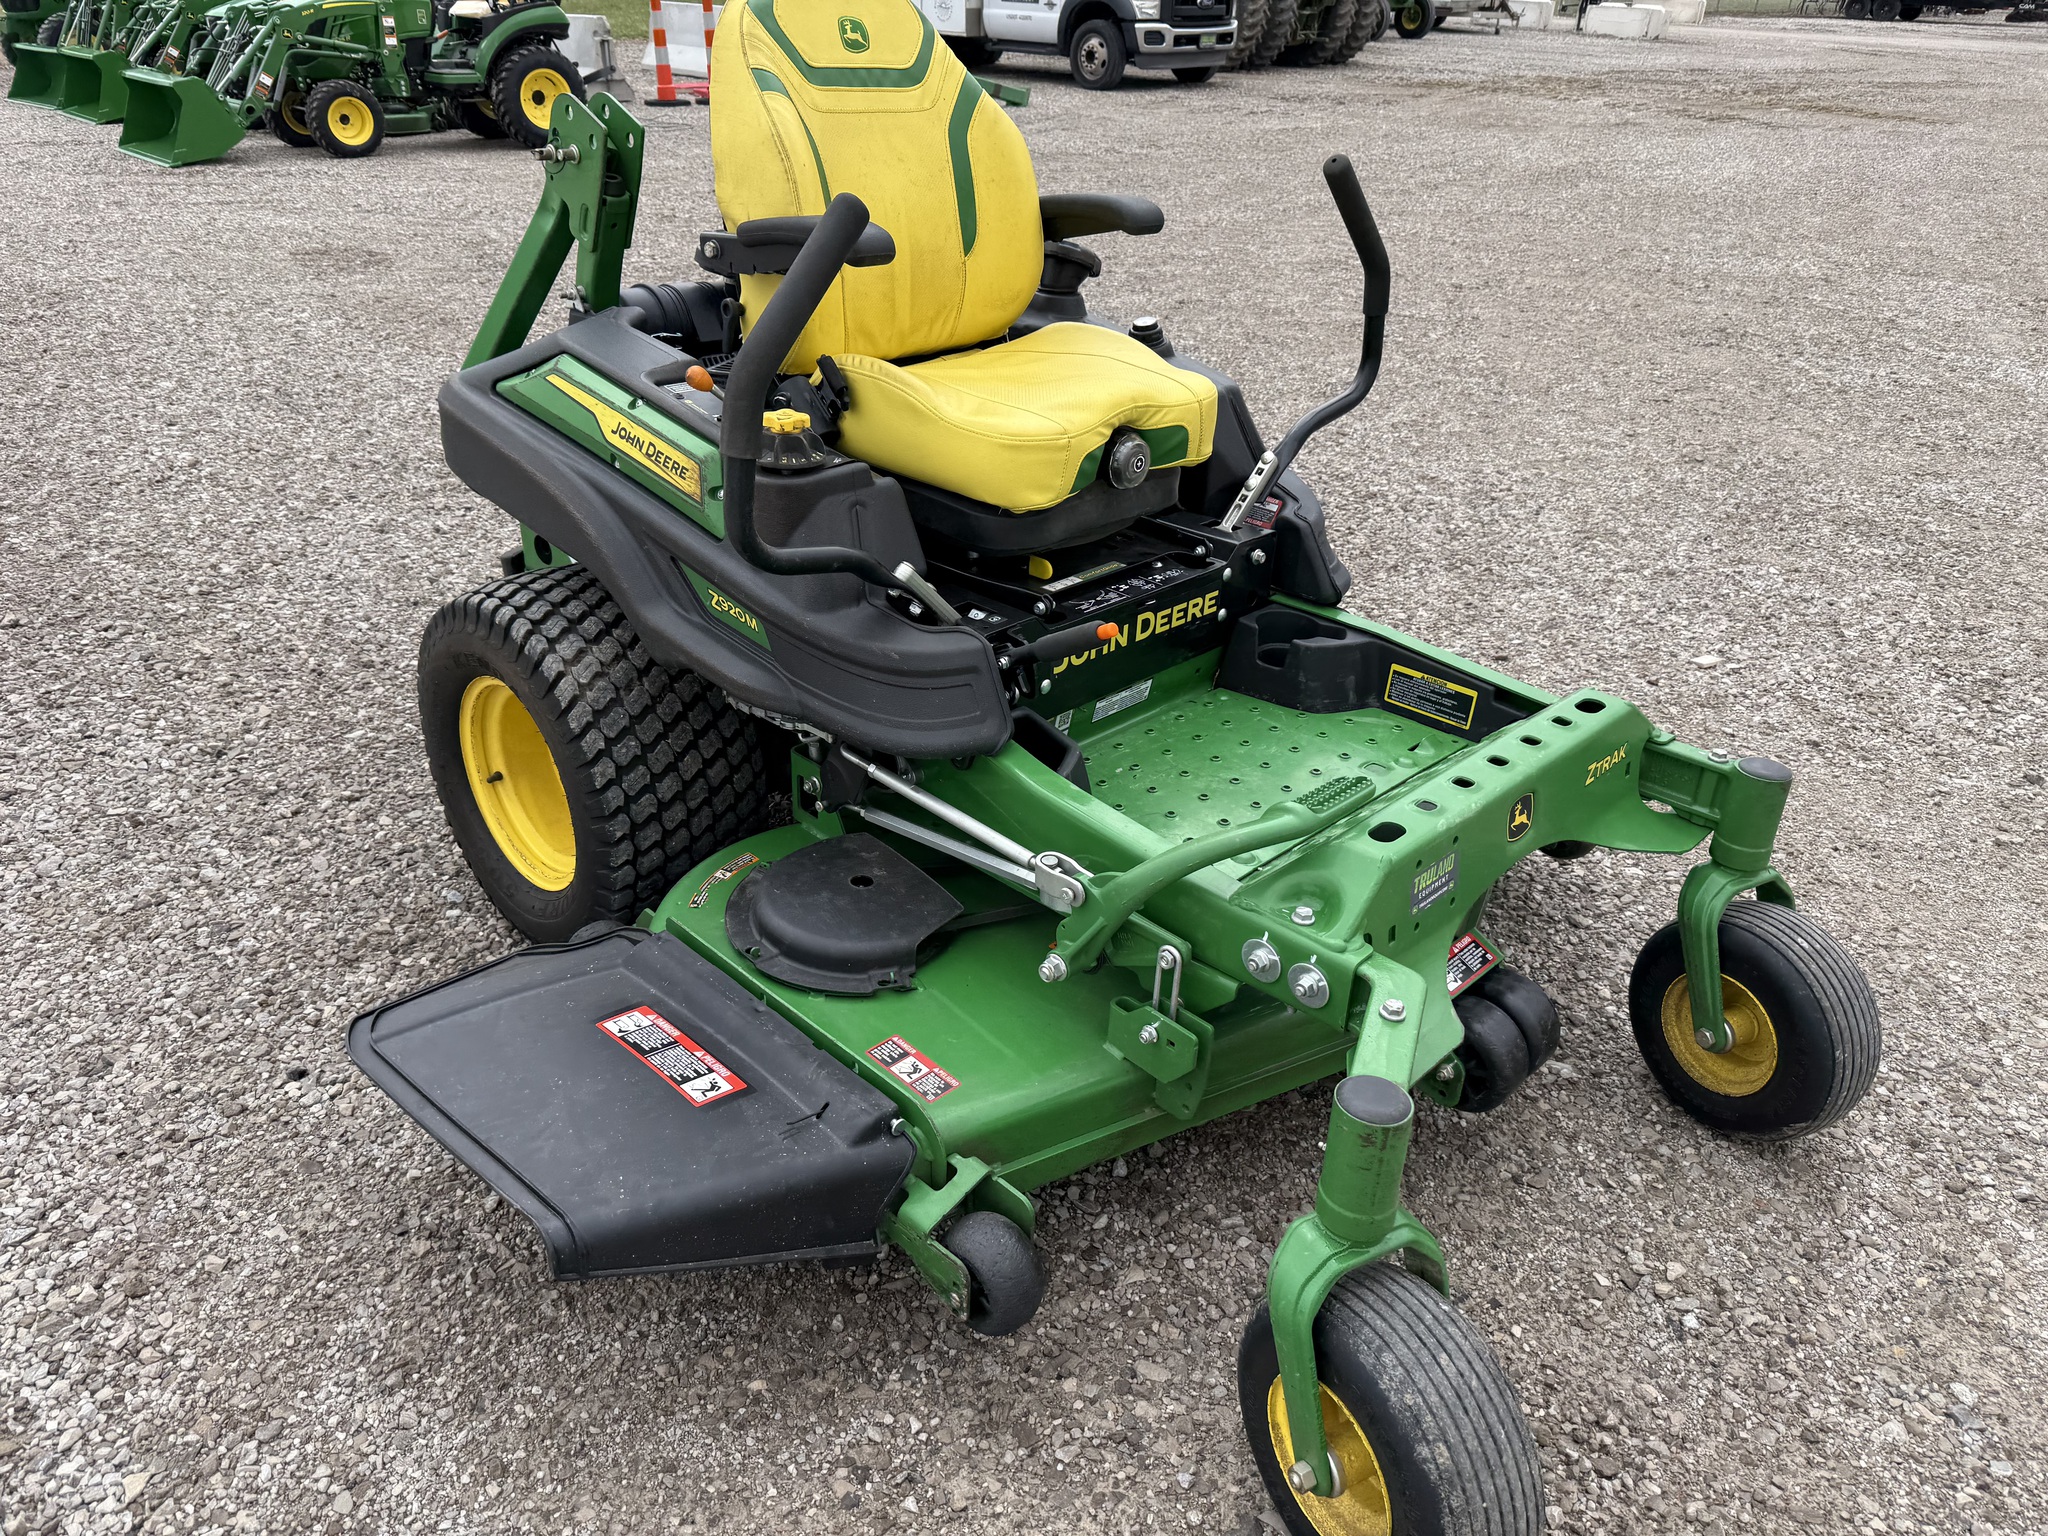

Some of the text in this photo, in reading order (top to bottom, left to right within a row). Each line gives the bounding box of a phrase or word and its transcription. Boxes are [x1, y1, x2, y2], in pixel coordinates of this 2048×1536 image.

[610, 421, 689, 480] JOHN DEERE
[707, 588, 759, 632] Z920M
[1135, 590, 1219, 642] DEERE
[1585, 742, 1628, 786] ZTRAK
[1414, 853, 1455, 894] TRULAND
[1418, 873, 1449, 899] EQUIPMENT
[1455, 935, 1472, 949] PELIGRO
[654, 1017, 681, 1037] DANGER
[897, 1038, 917, 1055] DANGER
[702, 1055, 731, 1077] PELIGRO
[937, 1069, 959, 1087] PELIGRO
